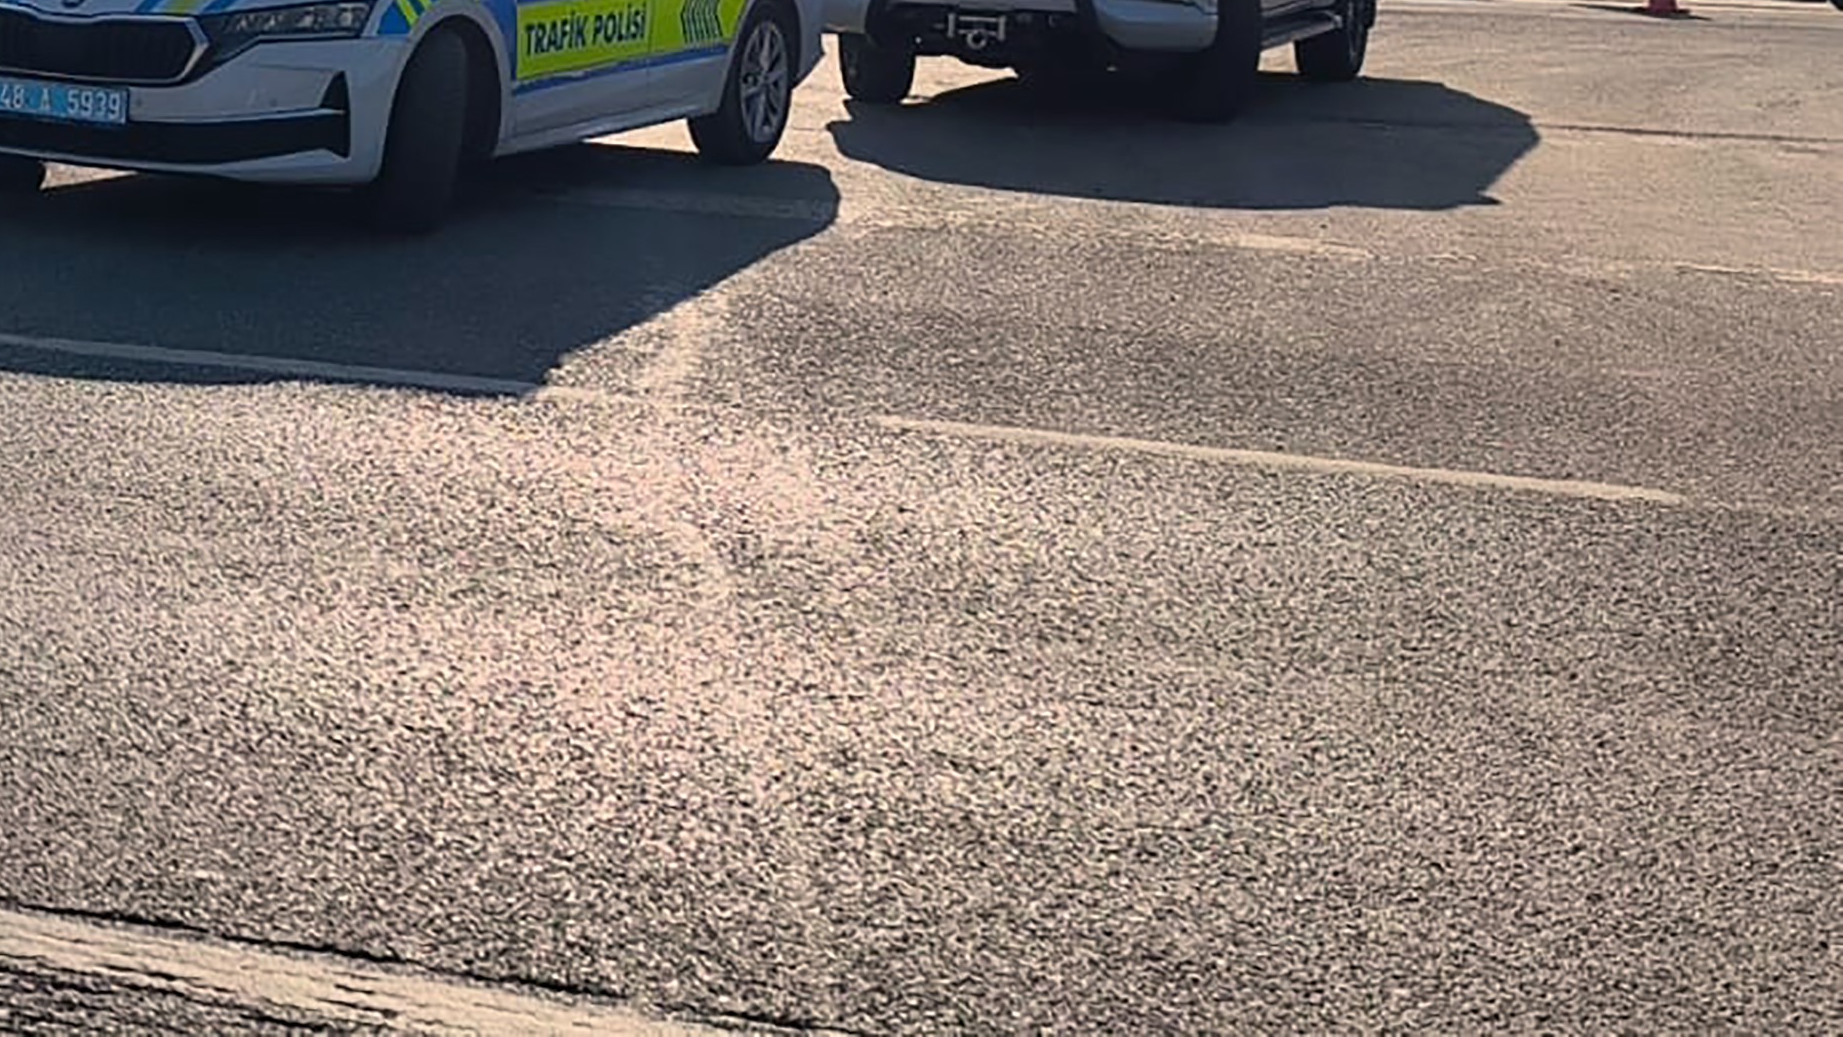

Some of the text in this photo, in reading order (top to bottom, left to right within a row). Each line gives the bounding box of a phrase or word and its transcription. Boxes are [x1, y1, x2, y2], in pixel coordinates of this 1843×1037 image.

[525, 3, 647, 56] TRAFİK POLİSİ
[0, 83, 121, 120] 48 A 5939
